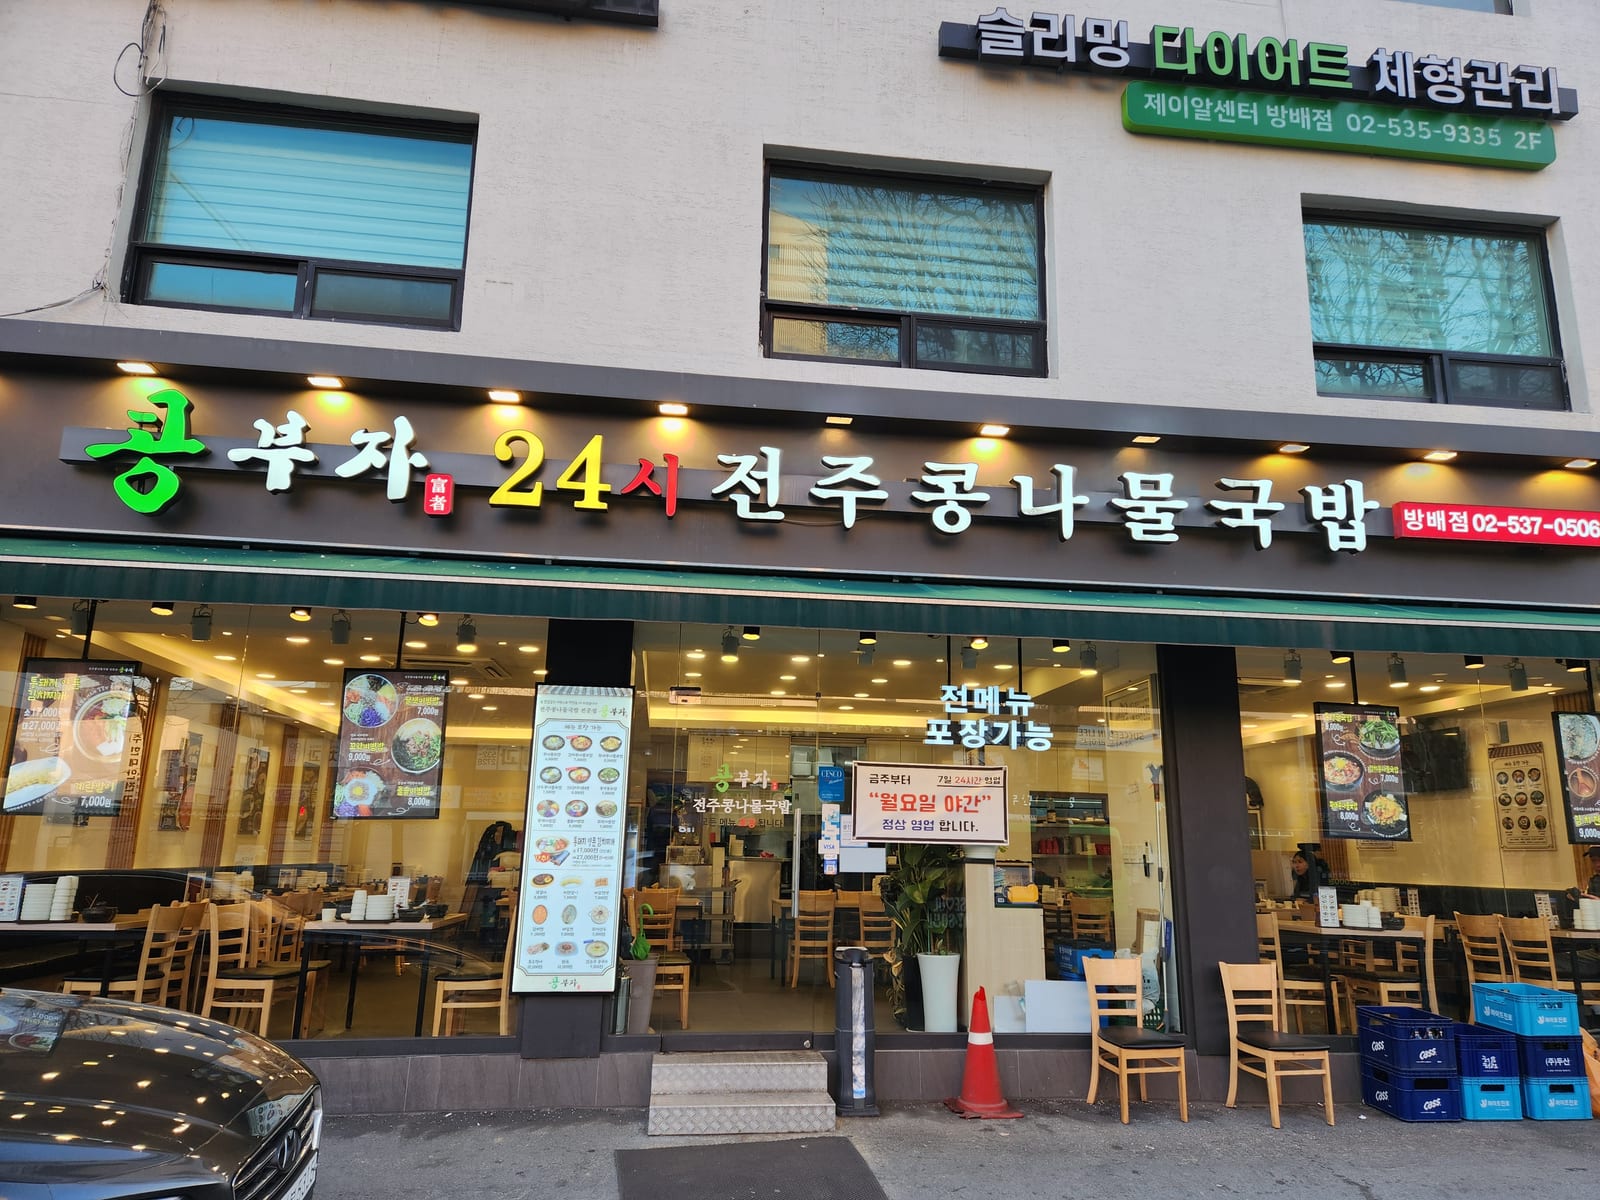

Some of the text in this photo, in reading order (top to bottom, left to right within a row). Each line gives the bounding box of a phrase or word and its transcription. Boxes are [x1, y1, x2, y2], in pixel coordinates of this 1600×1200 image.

[977, 7, 1561, 114] 슬리밍 다이어트 체형관리
[1143, 93, 1542, 151] 제이알센터 방배점 02-535-9335 2F
[489, 429, 679, 517] 24시
[711, 446, 1380, 551] 전주콩나물국밥
[1403, 509, 1600, 539] 방배점 02-537-0506
[940, 684, 1035, 717] 전메뉴
[923, 719, 1054, 752] 포장가능
[869, 773, 911, 785] 금주부터
[938, 775, 1001, 785] 7일 24시간 영업
[692, 797, 793, 815] 전주콩나물국밥
[882, 819, 907, 831] 정상
[911, 819, 934, 832] 영업
[1371, 1040, 1385, 1052] Cass
[1419, 1047, 1438, 1060] Cass
[1375, 1090, 1389, 1102] Cass
[1423, 1098, 1442, 1111] Cass
